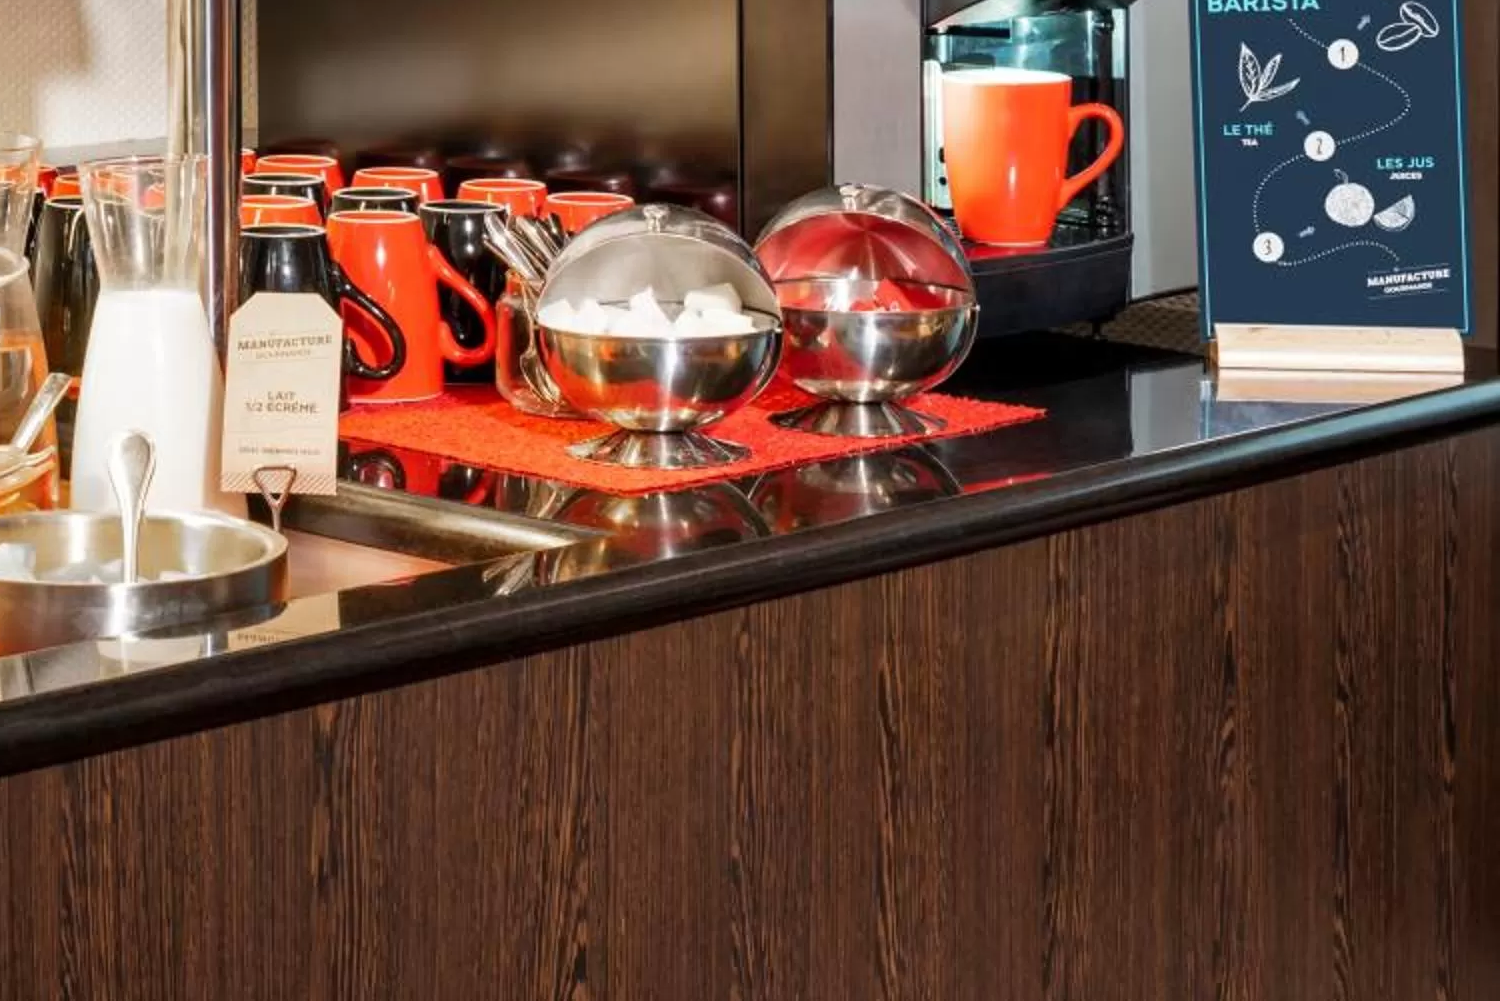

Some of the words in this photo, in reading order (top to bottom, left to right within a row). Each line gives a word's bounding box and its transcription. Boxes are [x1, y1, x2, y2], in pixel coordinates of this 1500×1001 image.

[1223, 124, 1242, 136] LE
[1245, 120, 1273, 135] THÉ
[1376, 158, 1403, 169] LES
[1408, 156, 1435, 168] JUS
[1367, 268, 1451, 287] MANUFACTURE
[237, 335, 333, 351] MANUFACTURE
[267, 390, 296, 400] LAIT
